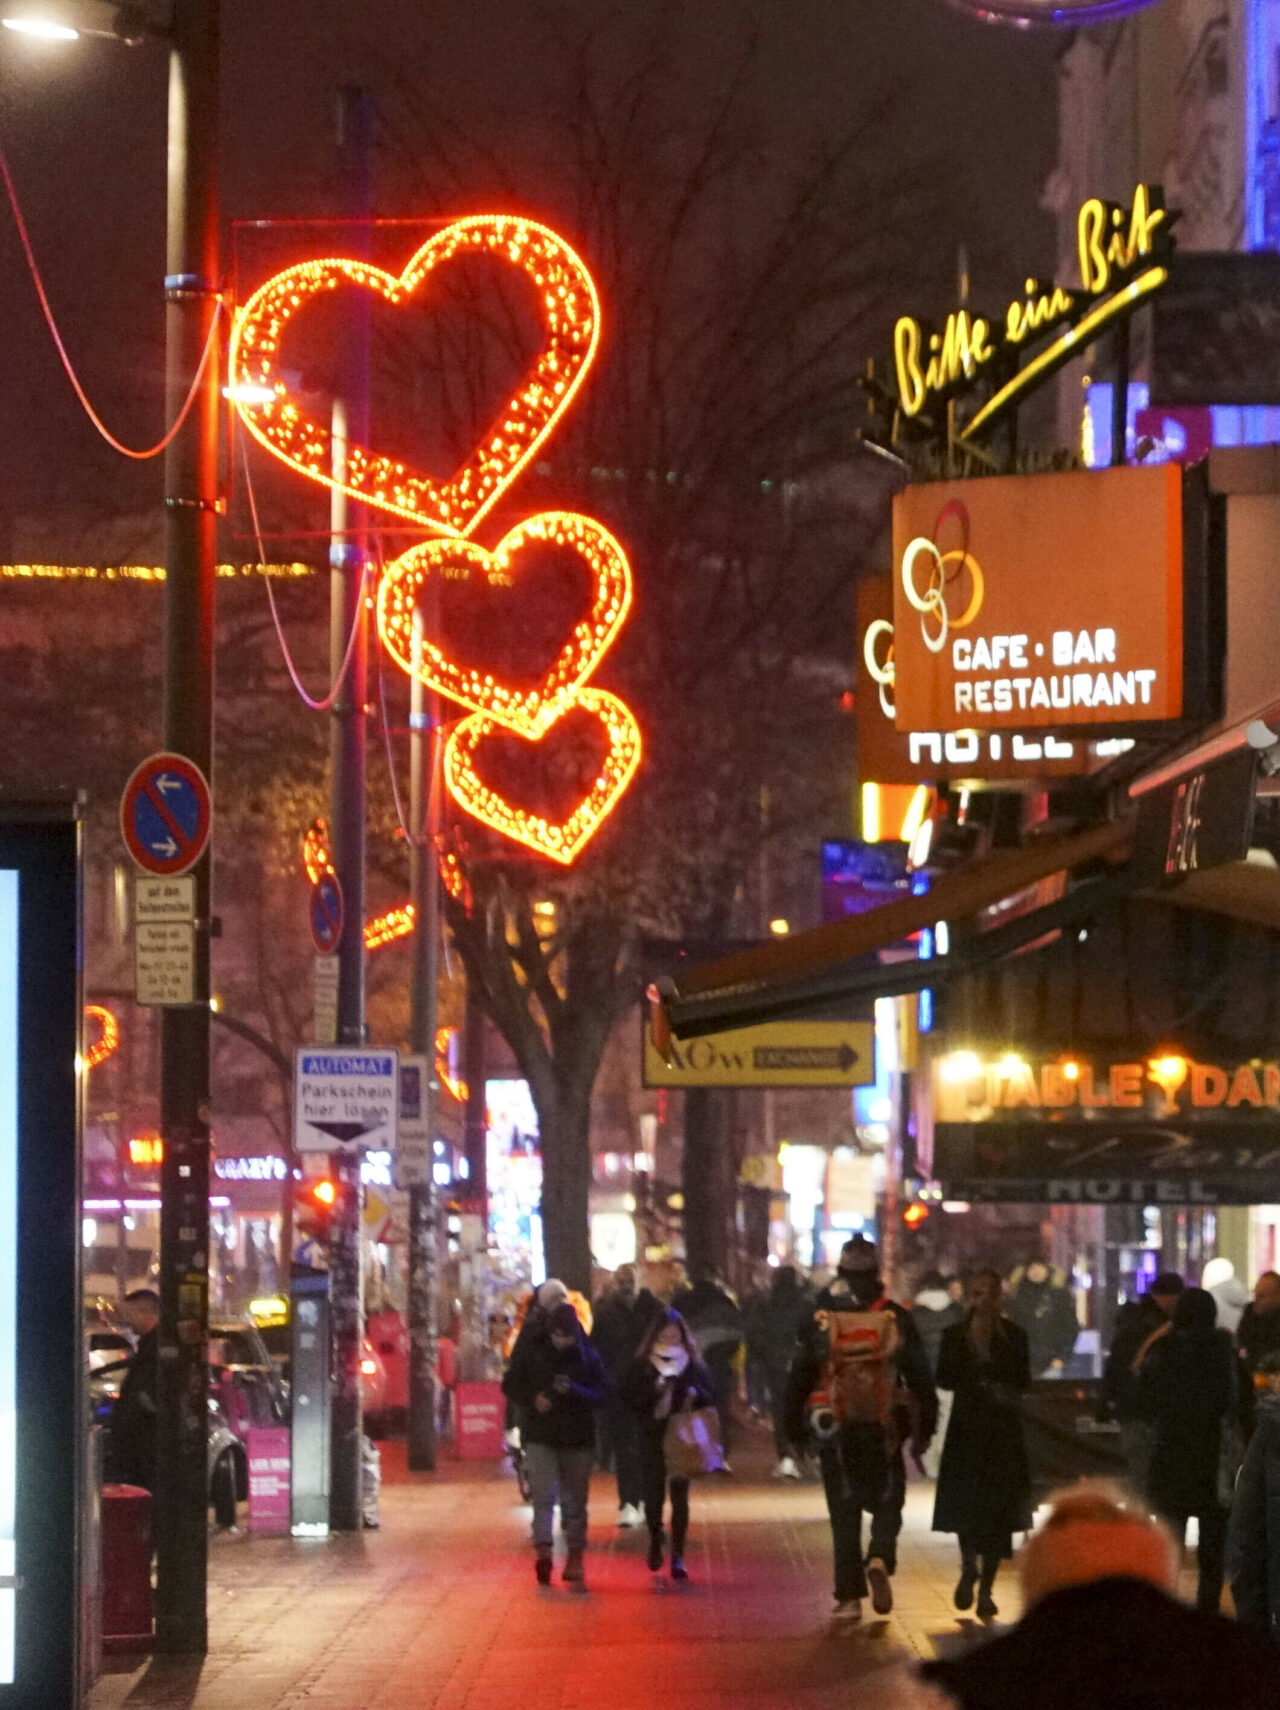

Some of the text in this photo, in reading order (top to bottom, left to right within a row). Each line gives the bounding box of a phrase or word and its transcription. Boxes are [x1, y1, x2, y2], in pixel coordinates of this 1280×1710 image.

[895, 183, 1166, 417] Bitte ein Bit
[952, 628, 1117, 671] CAFE BAR
[954, 669, 1157, 713] RESTAURANT
[307, 1057, 387, 1075] AUTOMAT
[984, 1063, 1144, 1108] TABLE
[301, 1083, 392, 1099] Parkschein
[304, 1103, 336, 1117] hier
